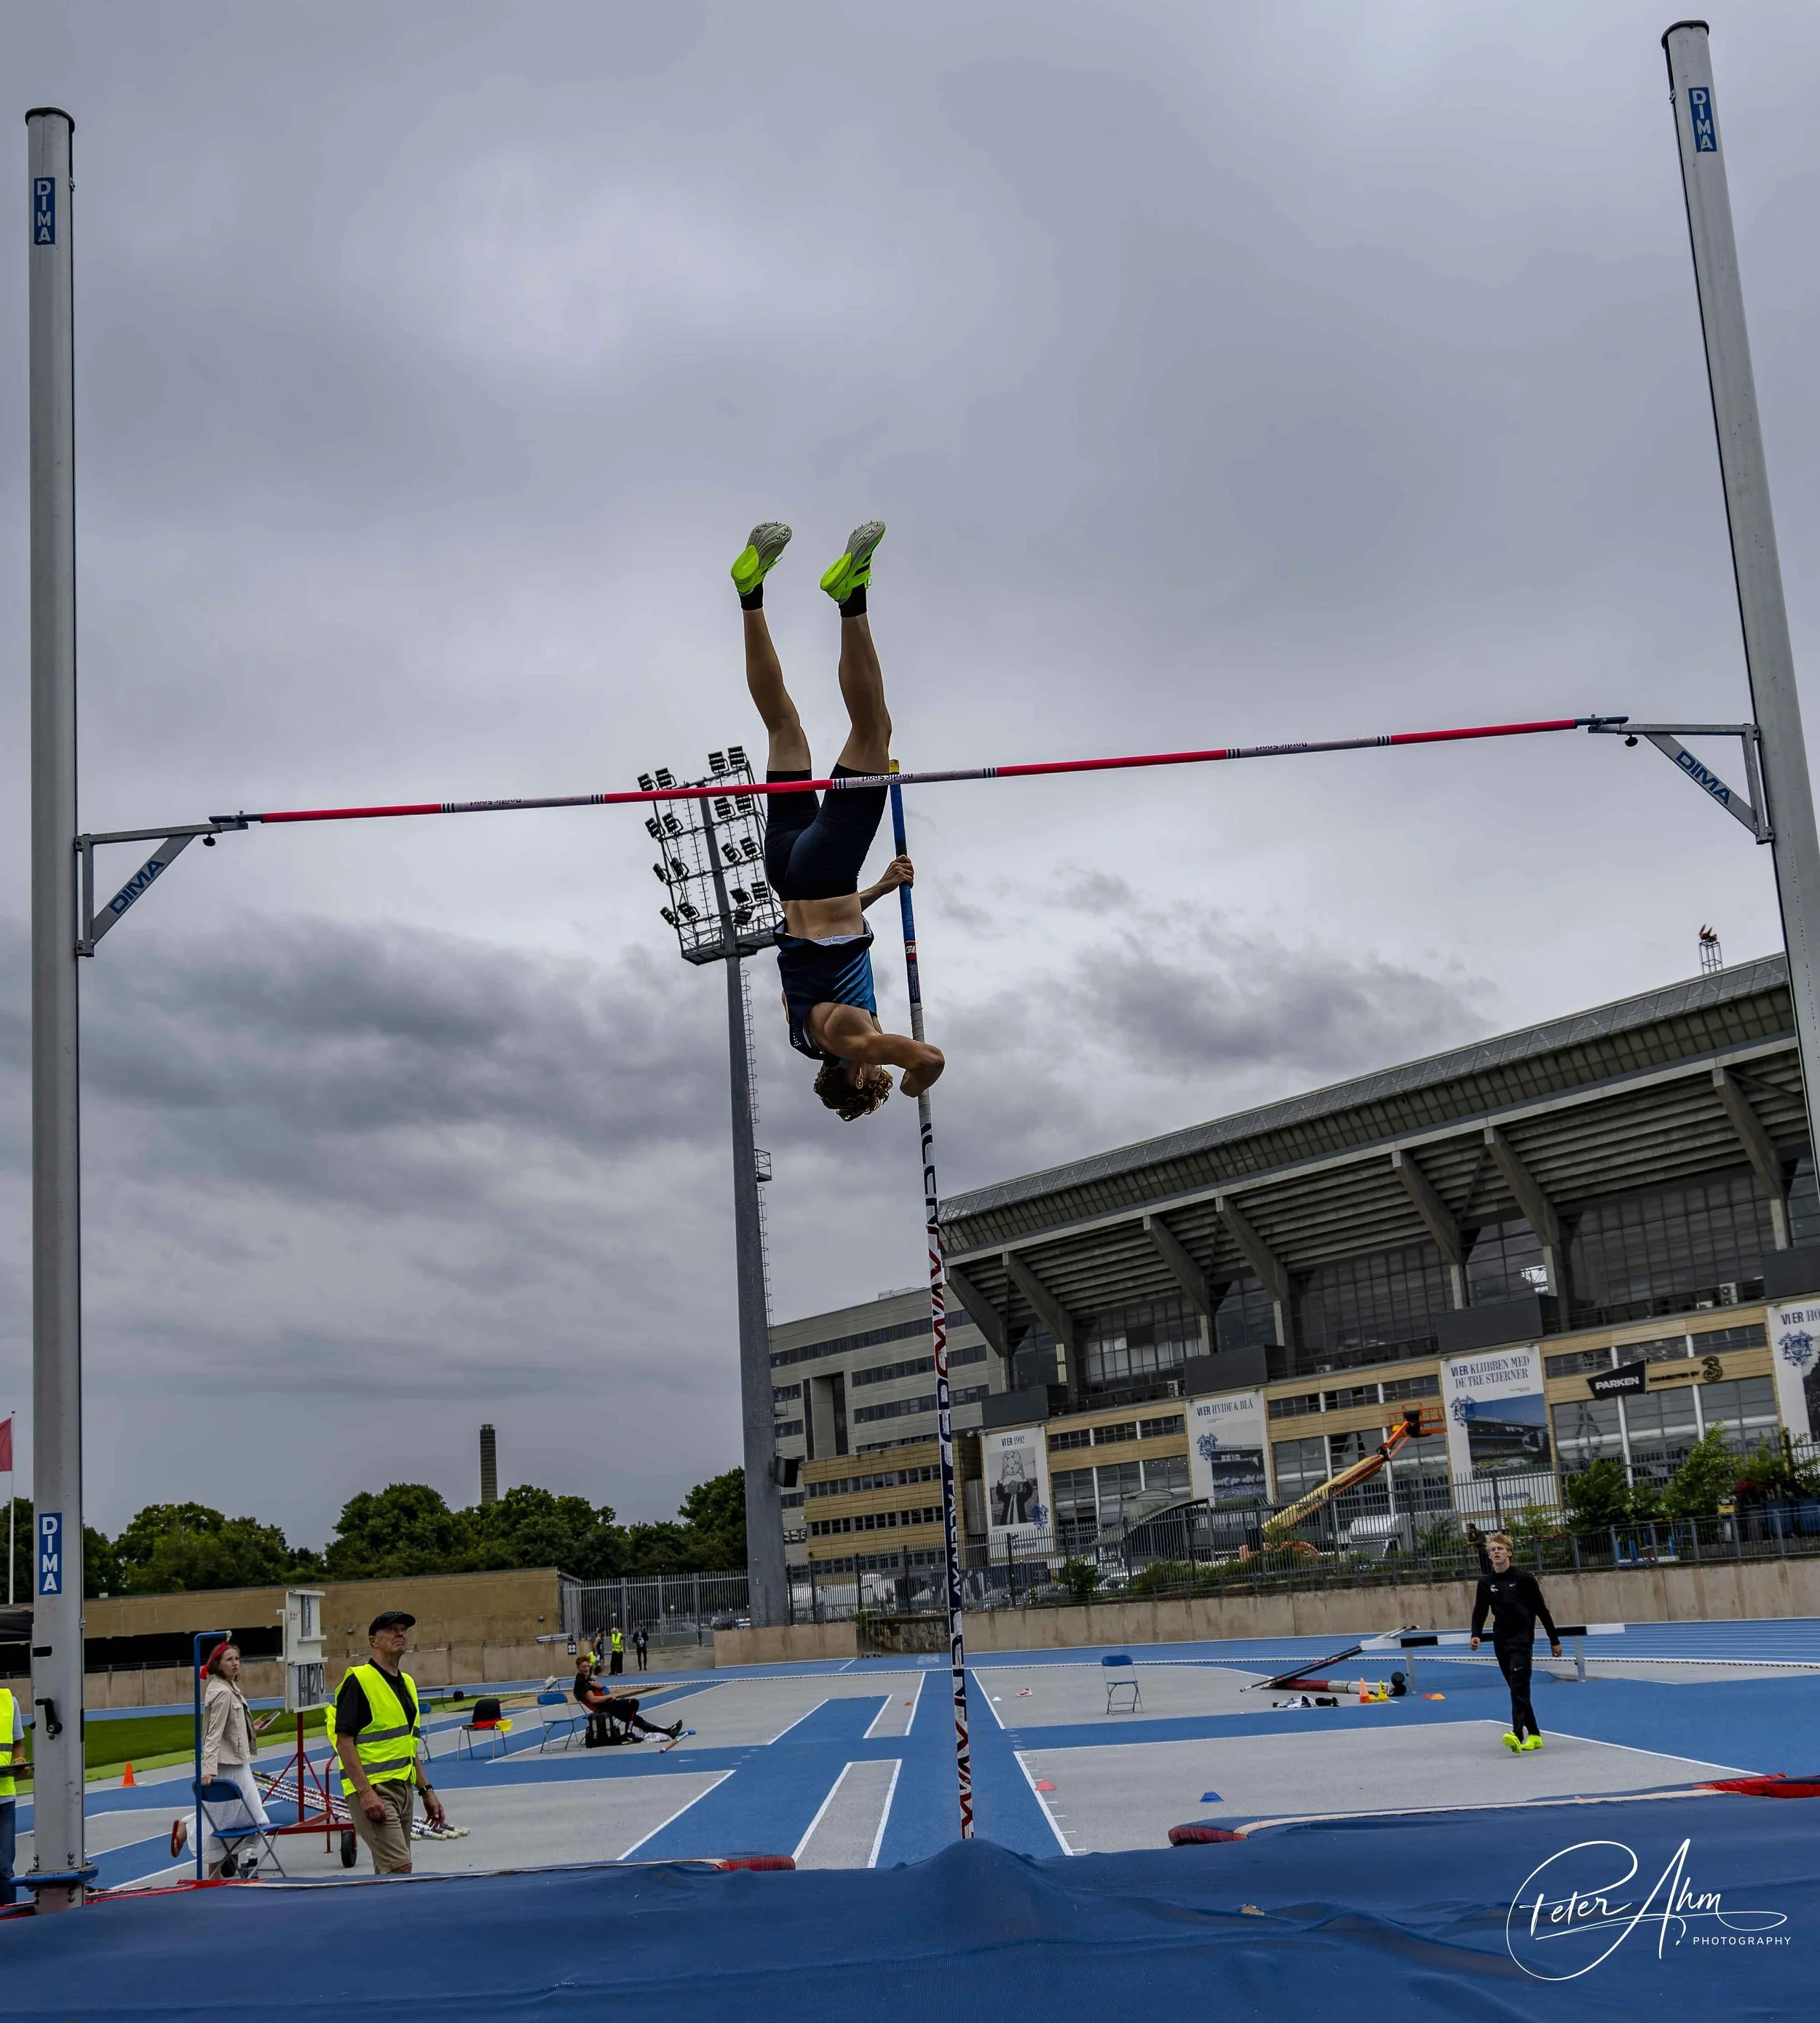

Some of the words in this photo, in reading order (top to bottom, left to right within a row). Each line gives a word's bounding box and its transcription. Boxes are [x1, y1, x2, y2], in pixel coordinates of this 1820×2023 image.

[1691, 90, 1714, 150] DIMA
[36, 180, 51, 242] DIMA
[1675, 750, 1732, 806] DIMA
[108, 859, 165, 915] DIMA
[1455, 1377, 1466, 1389] DE
[1468, 1374, 1484, 1387] TRE
[1486, 1368, 1529, 1385] STJERNER
[1469, 1358, 1509, 1374] KLUBBEN
[1511, 1355, 1530, 1368] MED
[1595, 1376, 1639, 1390] PARKEN
[1211, 1402, 1233, 1414] HVIDE
[1240, 1398, 1254, 1410] BLÅ
[1013, 1435, 1025, 1446] 1992
[42, 1516, 58, 1592] DIMA
